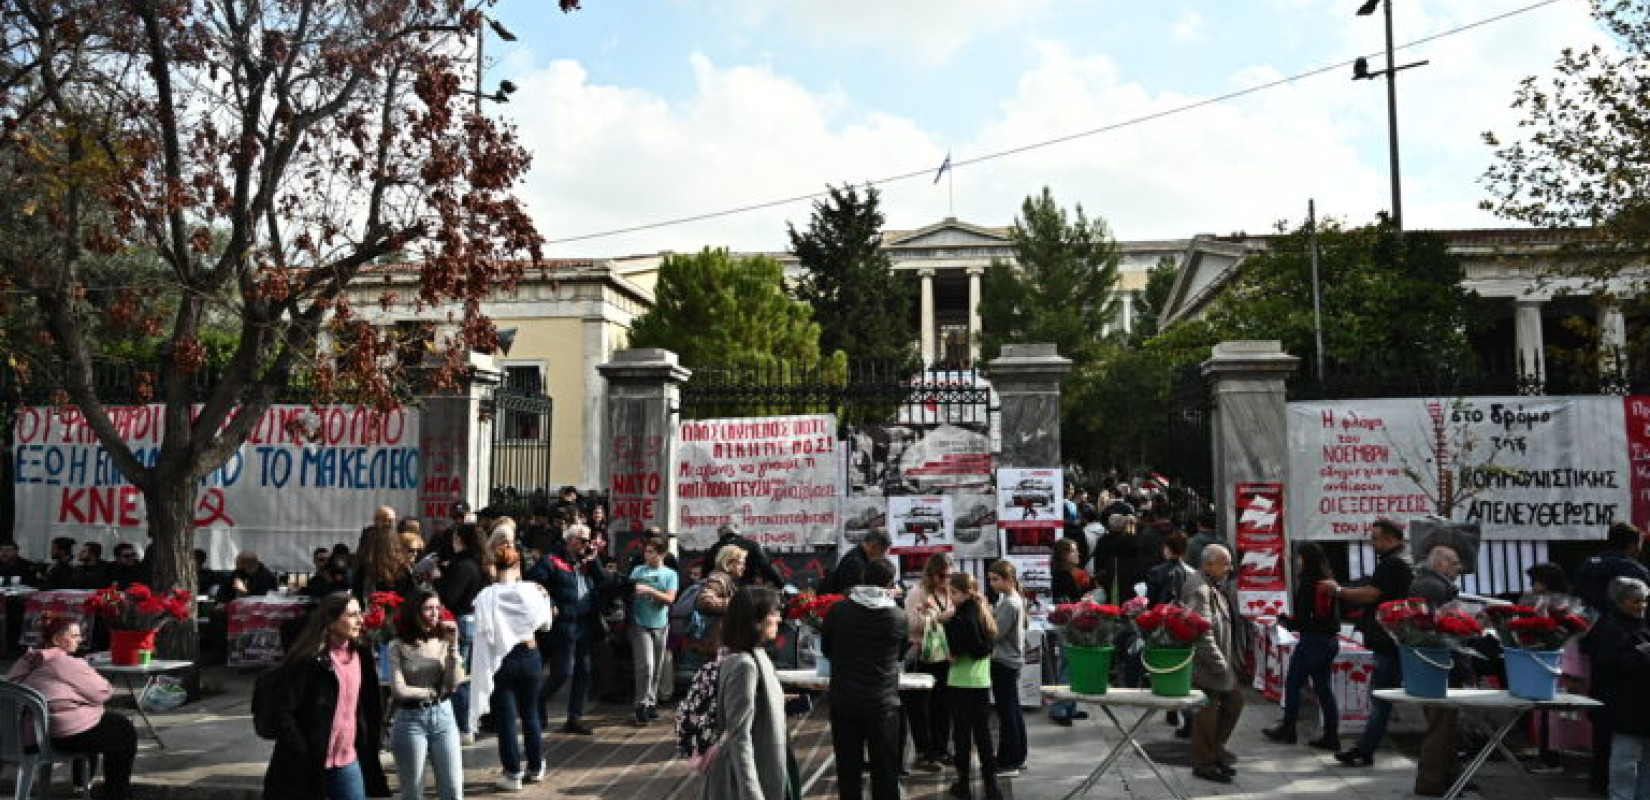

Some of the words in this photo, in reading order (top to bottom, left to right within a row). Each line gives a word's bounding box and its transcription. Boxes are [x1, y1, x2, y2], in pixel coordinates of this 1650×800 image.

[16, 406, 52, 443] ΟΙ
[1321, 408, 1334, 429] Η
[1491, 403, 1551, 431] δρόμο
[16, 444, 65, 485] ΕΞΩ
[69, 446, 87, 486] Η
[256, 447, 292, 488] ΤΟ
[301, 447, 418, 489] ΜΑΚΕΛΕΙΟ
[613, 472, 660, 494] ΝΑΤΟ
[59, 486, 140, 527] ΚΝΕ
